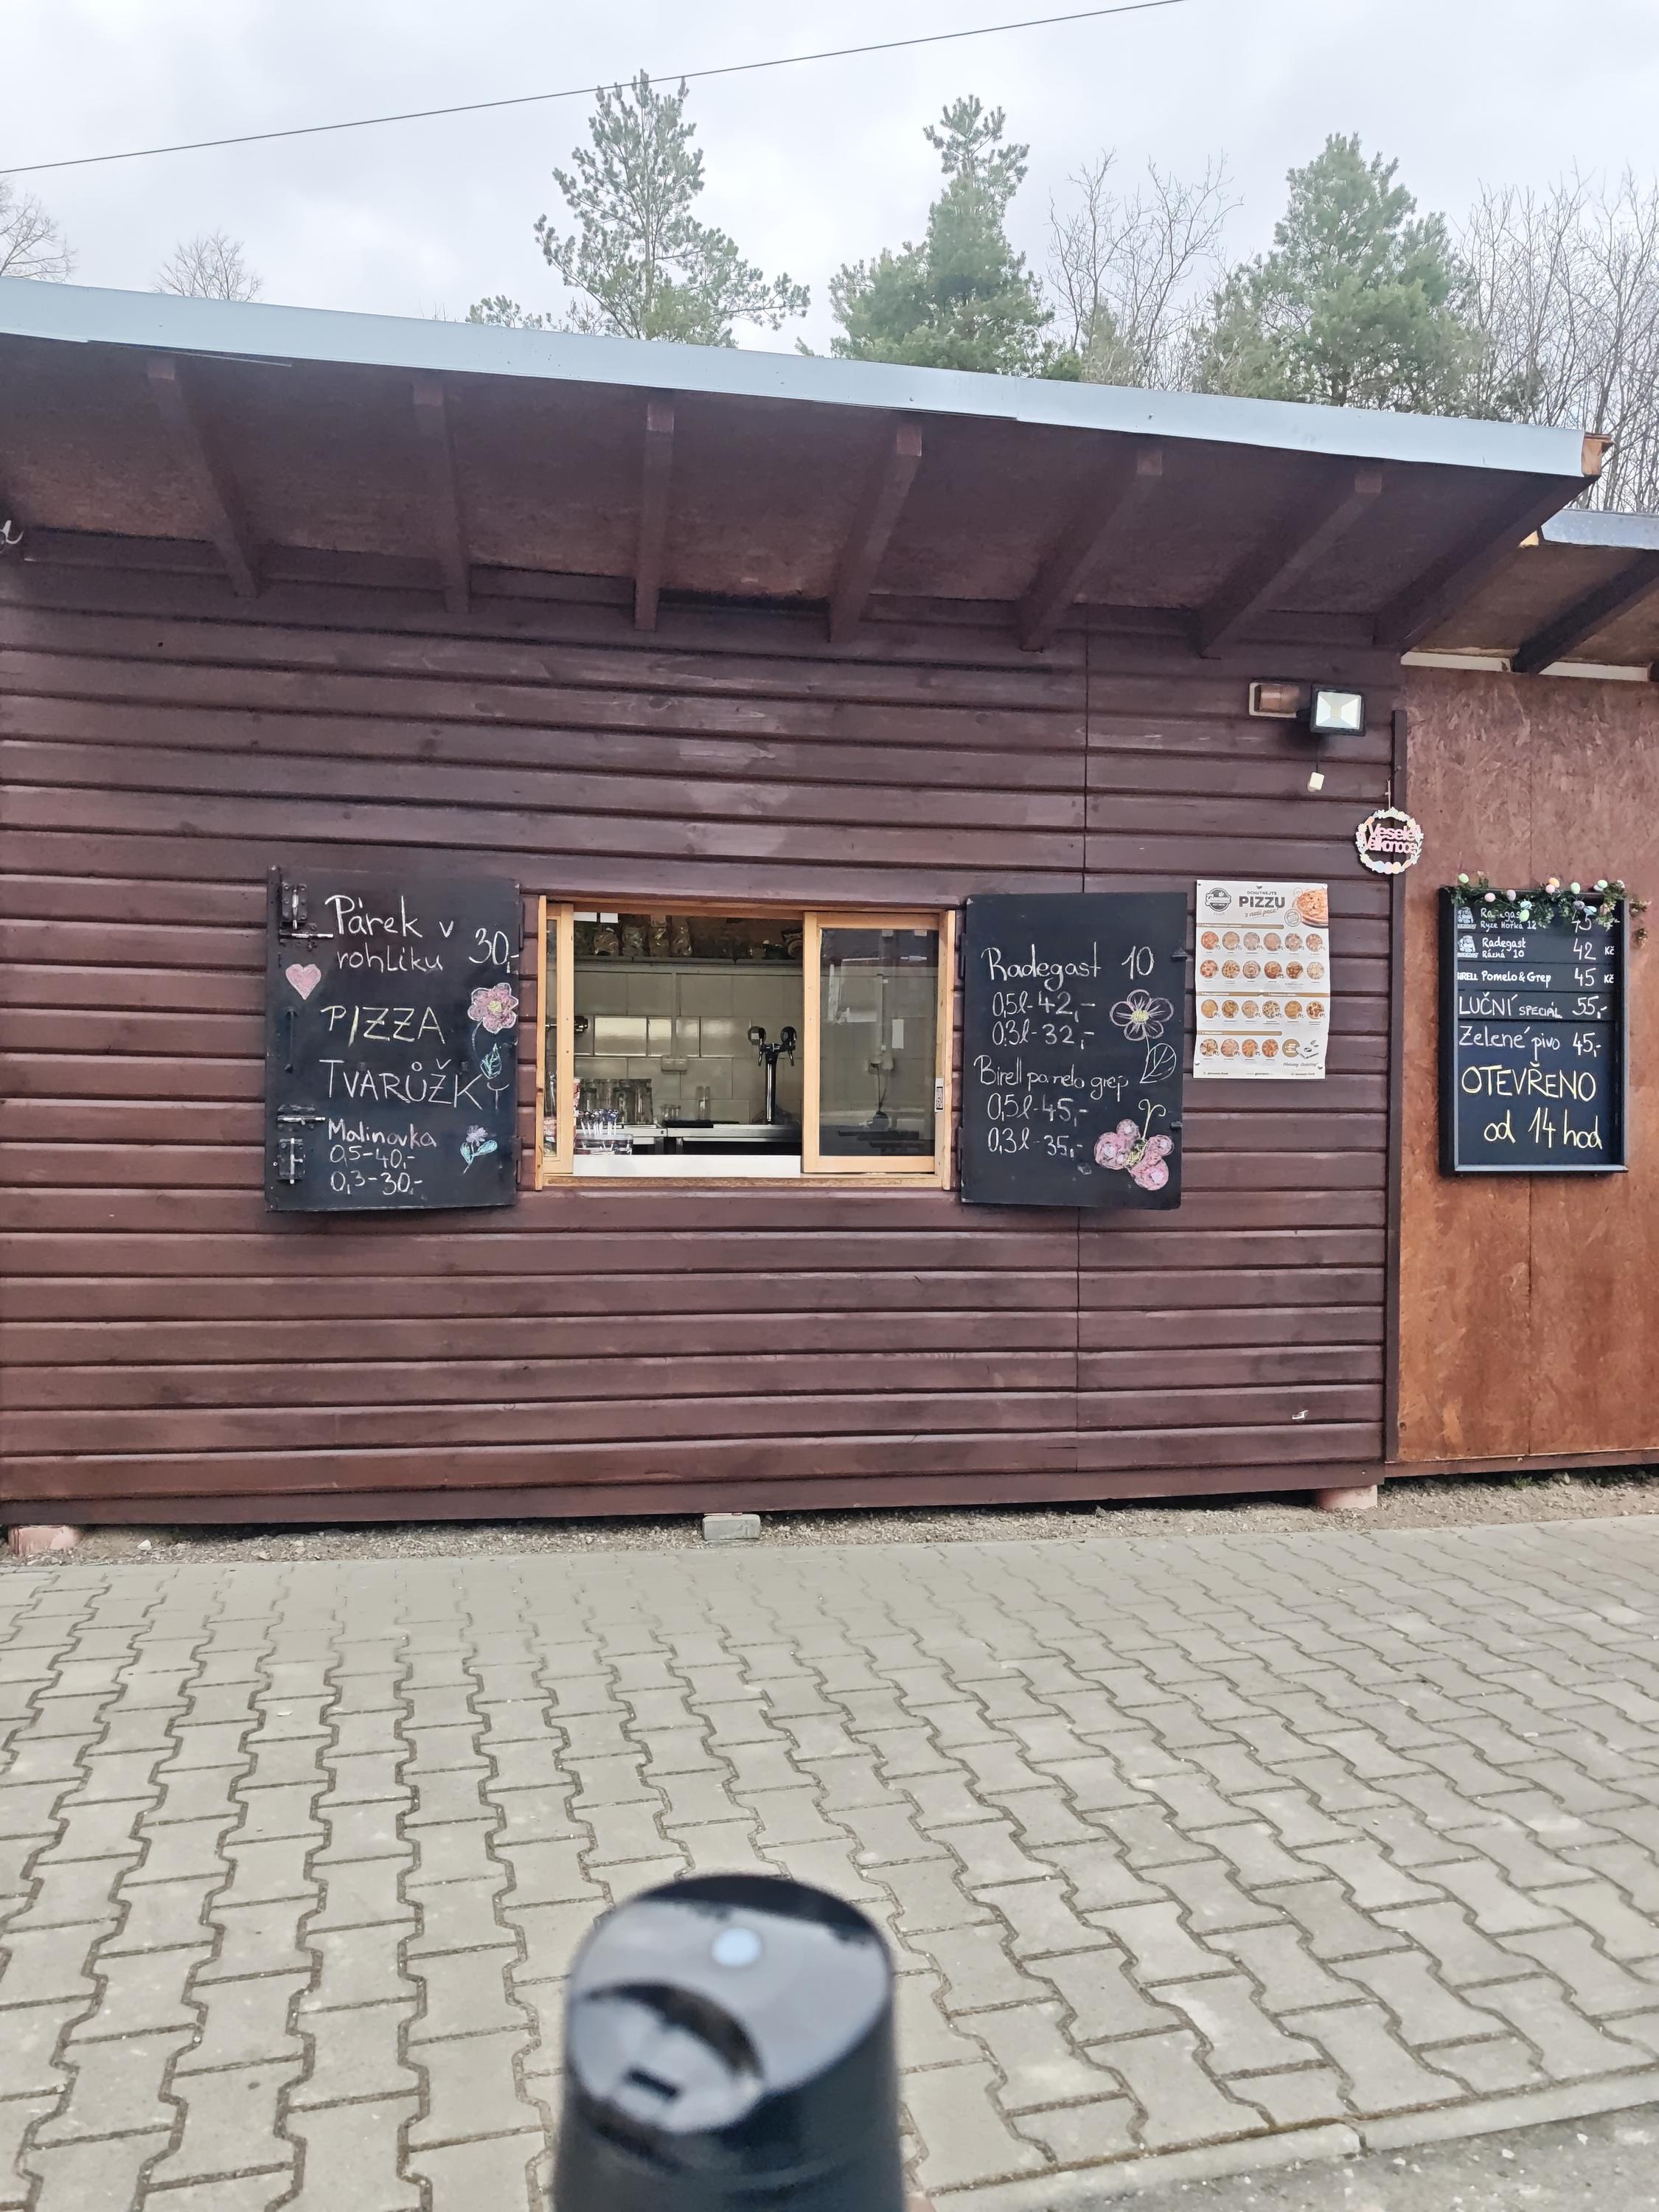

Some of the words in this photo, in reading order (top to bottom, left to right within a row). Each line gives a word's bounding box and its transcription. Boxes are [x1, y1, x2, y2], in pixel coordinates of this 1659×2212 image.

[325, 894, 423, 937] Párek
[439, 920, 454, 938] v
[1239, 896, 1285, 908] PIZZU
[1527, 920, 1537, 930] 12
[1482, 936, 1526, 951] Radegast
[1513, 949, 1525, 959] 10
[1573, 937, 1596, 961] 42
[1604, 945, 1615, 956] Kč
[981, 941, 1102, 992] Radegast
[1121, 945, 1155, 980] 10
[1574, 967, 1597, 987] 45
[1604, 973, 1615, 984] Kč
[1458, 992, 1517, 1016] LUČNÍ
[320, 1005, 445, 1048] PIZZA
[1458, 1026, 1530, 1048] Zelené
[1531, 1033, 1560, 1062] pivo
[319, 1058, 510, 1110] TVARŮŽKY
[973, 1054, 1022, 1086] Birell
[1461, 1062, 1596, 1102] OTEVŘENO
[328, 1118, 437, 1150] Malinovka
[1484, 1110, 1516, 1144] od
[1528, 1107, 1557, 1148] 14
[1563, 1109, 1603, 1150] hod
